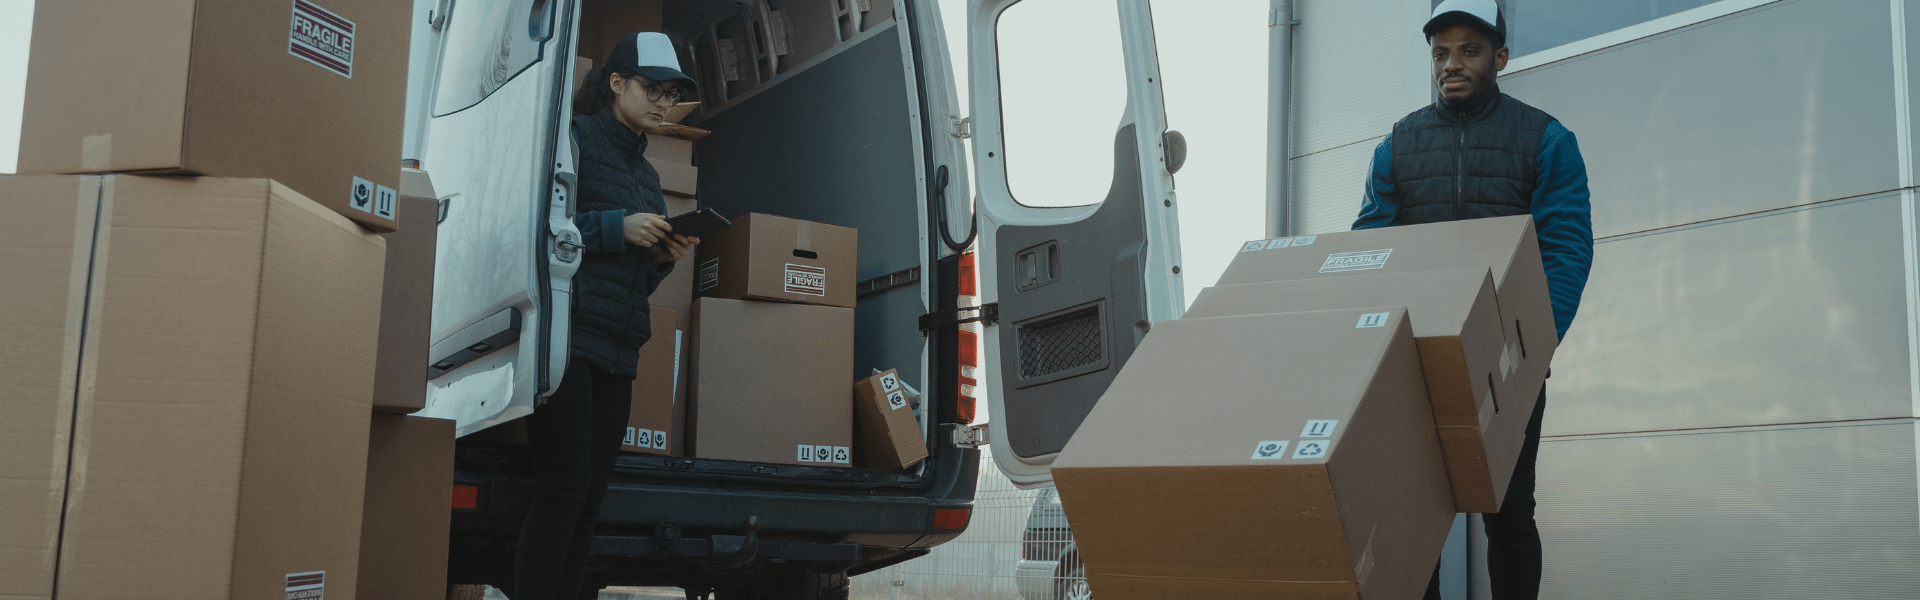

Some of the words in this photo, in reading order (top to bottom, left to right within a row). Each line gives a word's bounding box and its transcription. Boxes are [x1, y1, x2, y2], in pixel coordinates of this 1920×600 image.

[294, 15, 351, 54] FRAGILE
[293, 31, 318, 48] HANDLE
[318, 41, 334, 54] WITH
[333, 48, 350, 61] CARE
[1326, 254, 1386, 265] FRAGILE
[787, 275, 823, 287] FRAGILE
